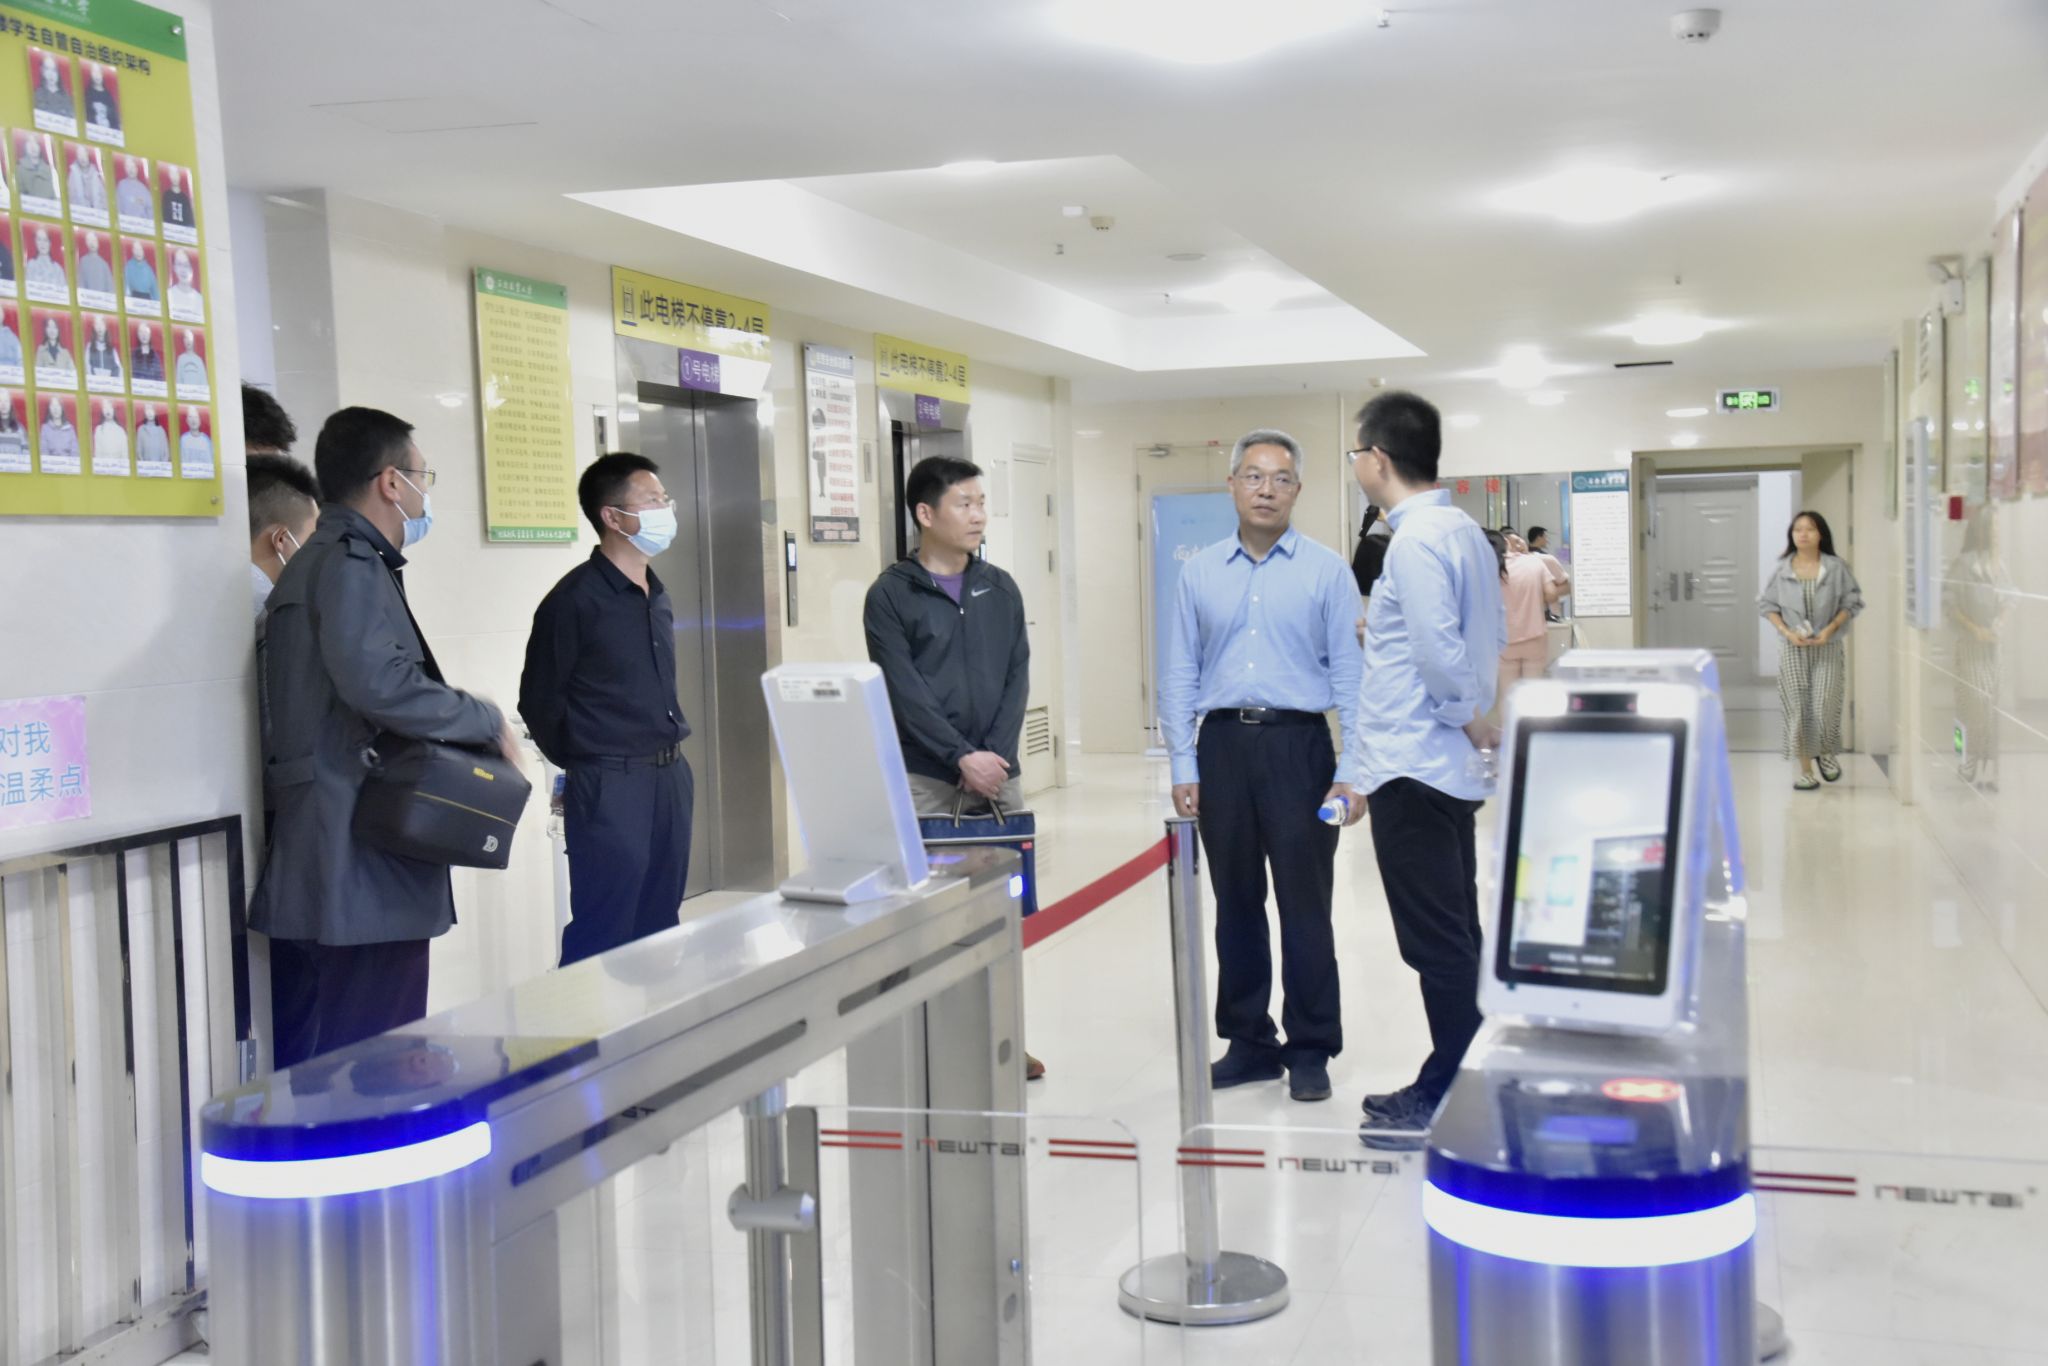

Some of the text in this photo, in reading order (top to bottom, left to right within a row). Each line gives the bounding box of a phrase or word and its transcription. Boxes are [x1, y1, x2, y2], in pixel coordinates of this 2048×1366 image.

[0, 721, 51, 758] 对我
[0, 764, 82, 806] 温柔点
